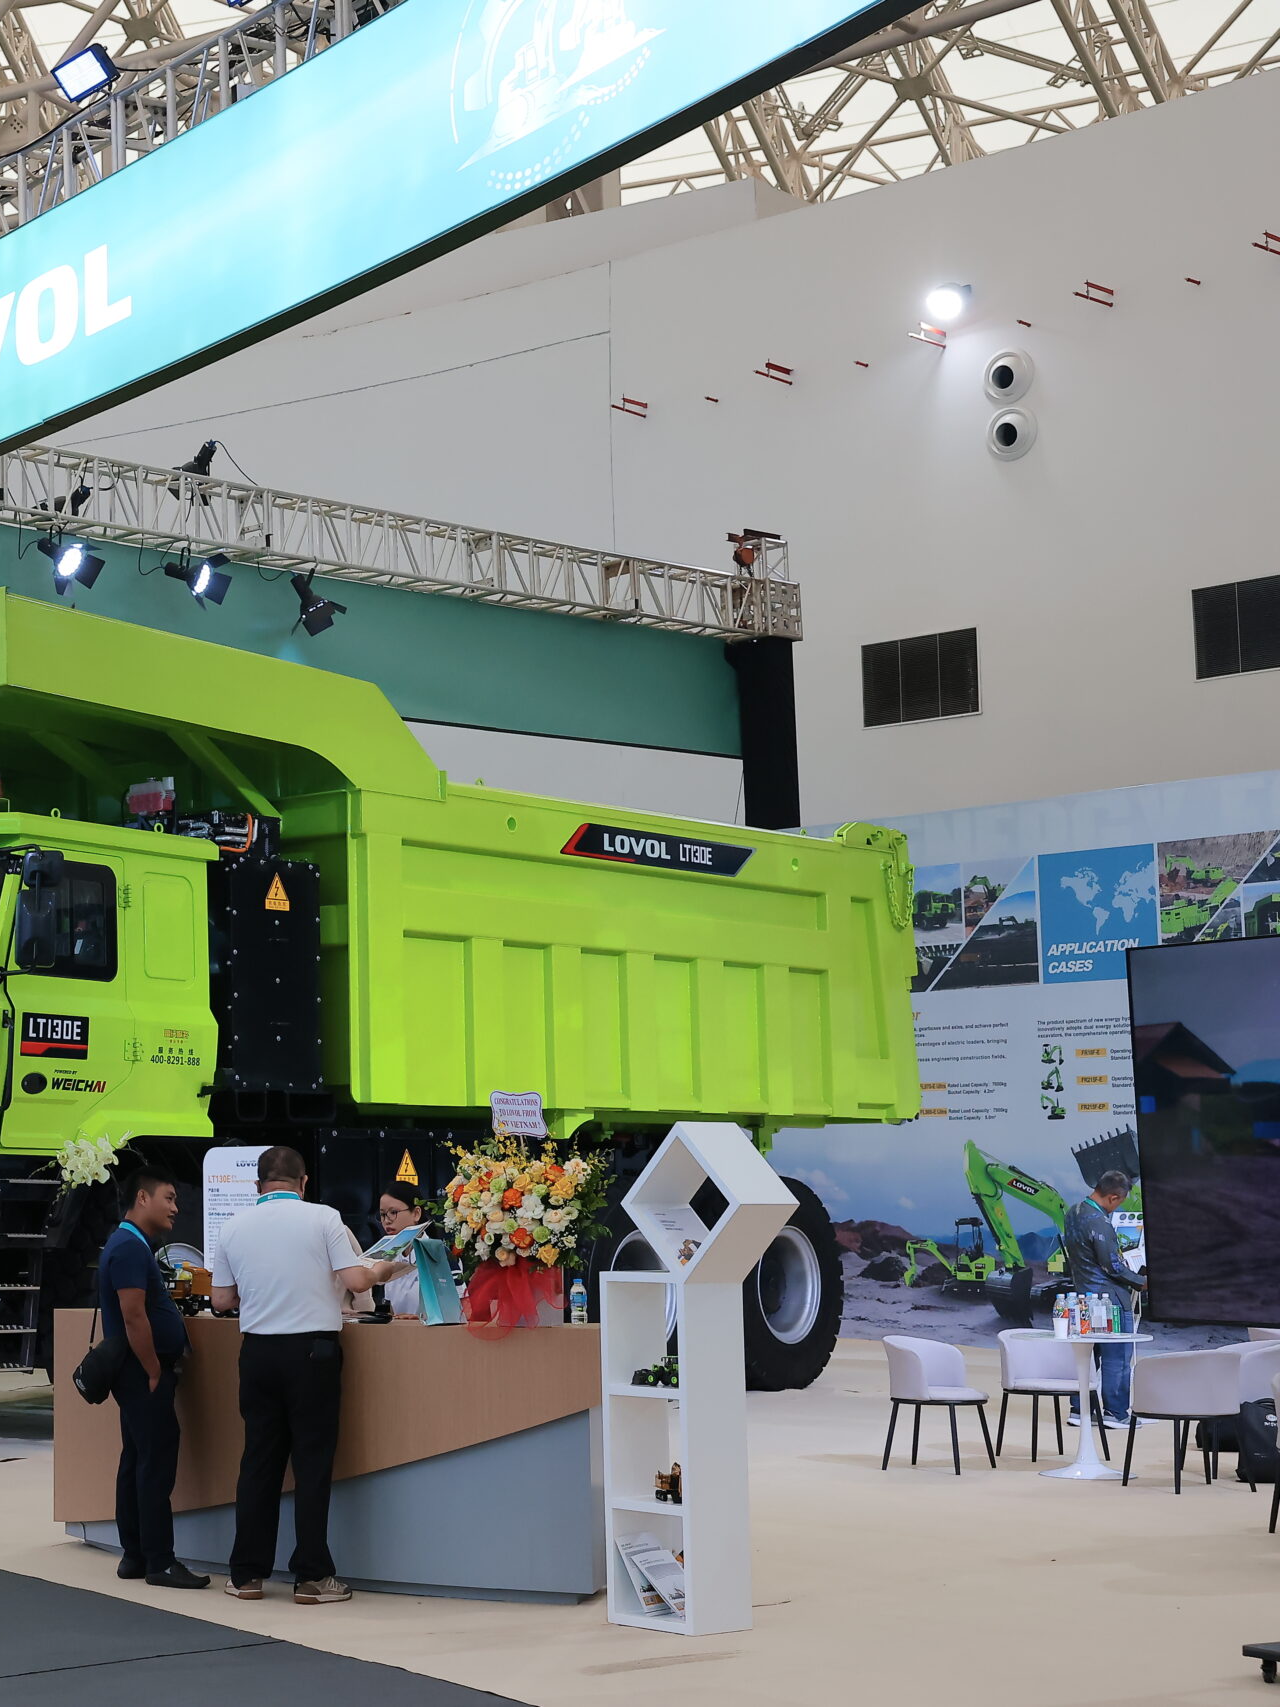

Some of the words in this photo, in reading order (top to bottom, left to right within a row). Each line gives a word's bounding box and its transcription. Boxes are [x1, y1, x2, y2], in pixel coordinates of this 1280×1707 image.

[603, 833, 671, 860] LOVOL
[679, 843, 713, 866] LT130E
[1047, 938, 1140, 956] APPLICATION
[1048, 959, 1093, 974] CASES
[28, 1017, 82, 1041] LT130E
[150, 1055, 201, 1066] 400-8291-888
[51, 1077, 107, 1093] WEICHAI
[208, 1175, 231, 1183] LT130E
[1012, 1180, 1036, 1195] LOVOL
